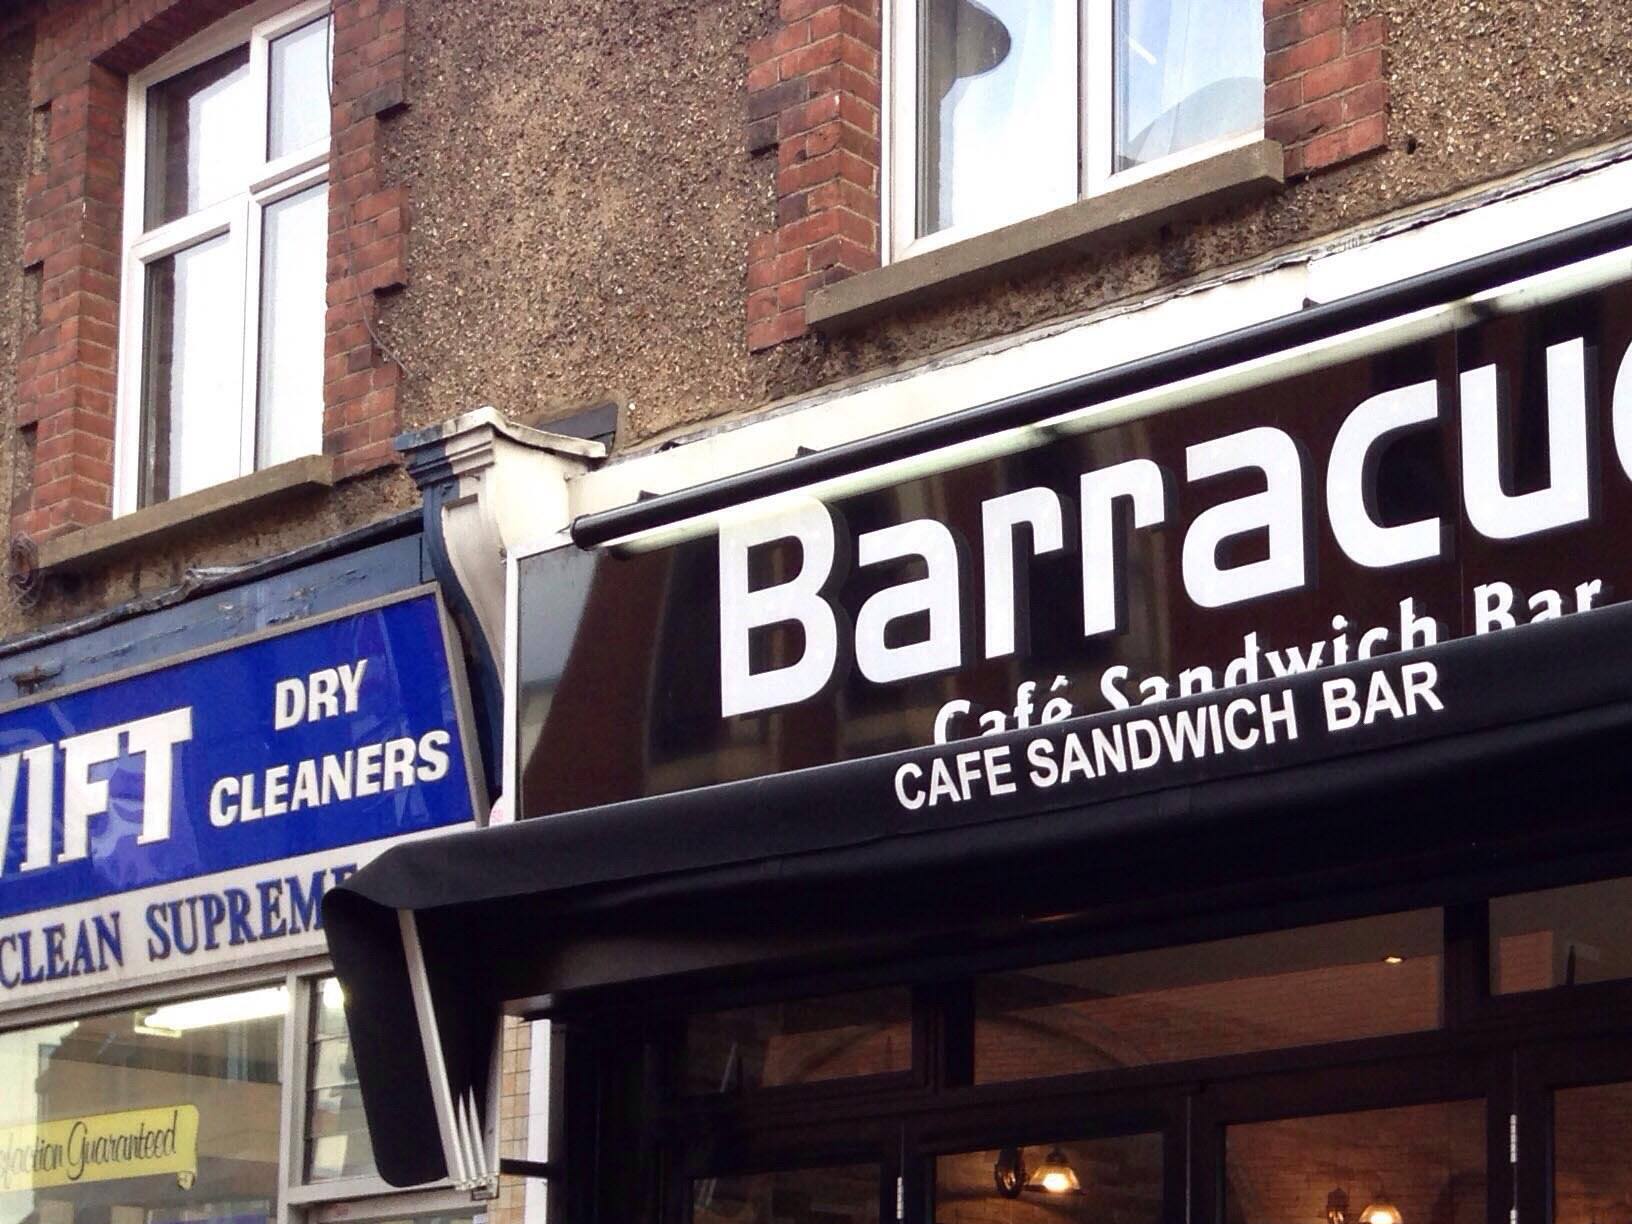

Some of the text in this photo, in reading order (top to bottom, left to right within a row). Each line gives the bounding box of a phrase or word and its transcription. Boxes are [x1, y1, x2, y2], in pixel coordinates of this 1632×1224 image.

[274, 658, 369, 731] DRY
[934, 578, 1603, 744] Café Sandwich Bar
[208, 729, 452, 828] CLEANERS
[894, 660, 1444, 811] CAFE SANDWICH BAR
[0, 705, 195, 874] IFT
[0, 912, 122, 989] CLEAN
[66, 1109, 177, 1181] Guaranteed
